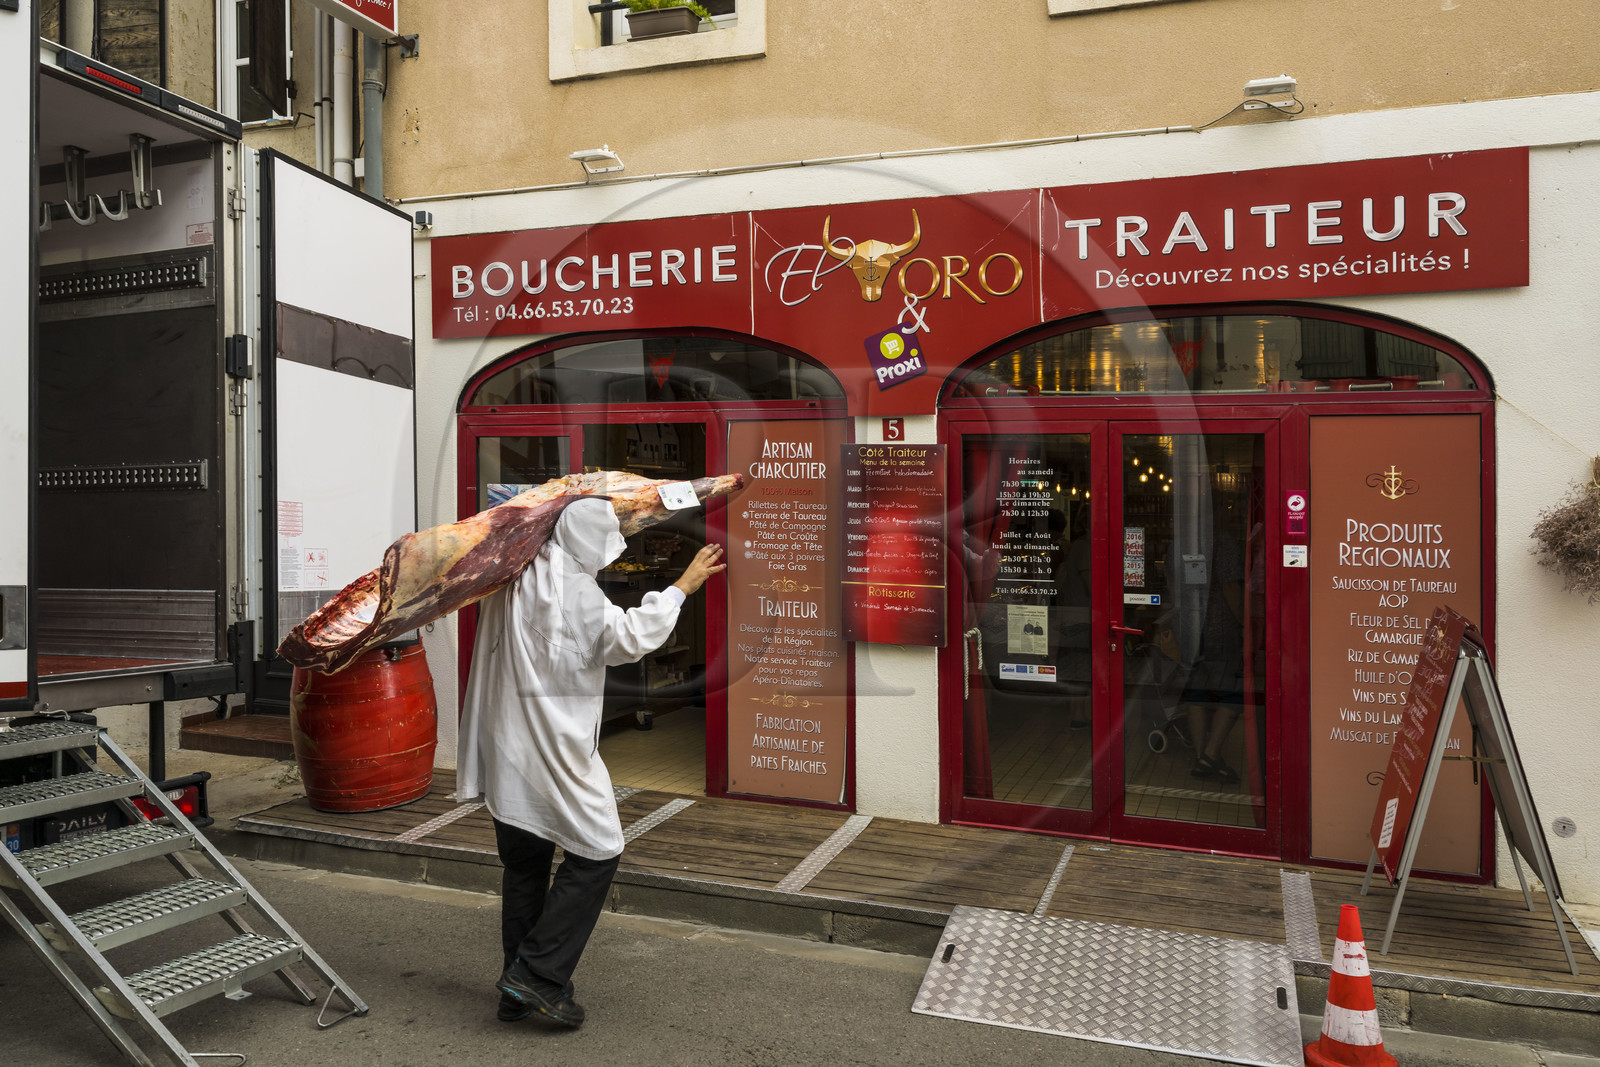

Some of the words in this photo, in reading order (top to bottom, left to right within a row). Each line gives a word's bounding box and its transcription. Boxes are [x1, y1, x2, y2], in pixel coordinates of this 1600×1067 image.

[1064, 192, 1470, 260] TRAITEUR
[451, 244, 738, 299] BOUCHERIE
[1095, 267, 1233, 290] Découvrez
[1241, 262, 1290, 282] nos
[1298, 249, 1452, 283] spécialités
[1463, 249, 1470, 269] !
[898, 253, 1024, 304] ORO
[453, 306, 479, 323] Tél
[495, 297, 634, 322] 04.66.53.70.23
[898, 293, 931, 334] &
[888, 419, 899, 439] 5
[761, 439, 813, 459] ARTISAN
[858, 446, 884, 457] Côté
[887, 446, 927, 458] Traiteur
[749, 462, 826, 479] CHARCUTIER
[1029, 491, 1050, 499] 19h30
[748, 500, 779, 509] Rillettes
[780, 501, 791, 509] de
[793, 501, 828, 510] Taureau
[749, 510, 778, 519] Terrine
[780, 511, 790, 520] de
[792, 511, 827, 520] Taureau
[749, 520, 767, 529] Pâté
[769, 521, 780, 529] de
[781, 521, 827, 532] Campagne
[1346, 518, 1443, 544] PRODUITS
[757, 530, 775, 540] Pâté
[777, 532, 788, 540] en
[789, 531, 819, 540] Croûte
[999, 531, 1021, 539] Juillet
[753, 540, 789, 551] Fromage
[791, 541, 802, 550] de
[805, 541, 823, 551] Tête
[1023, 543, 1060, 551] dimanche
[751, 550, 769, 560] Pâté
[770, 552, 786, 560] aux
[789, 552, 794, 560] 3
[796, 552, 825, 562] poivres
[1339, 542, 1451, 569] REGIONAUX
[768, 561, 785, 570] Foie
[787, 562, 807, 571] Gras
[869, 586, 916, 599] Rôtisserie
[1332, 576, 1390, 592] SAUCISSON
[1393, 580, 1407, 592] DE
[1409, 578, 1457, 594] TAUREAU
[758, 596, 818, 619] TRAITEUR
[1379, 594, 1409, 608] AOP
[1350, 612, 1383, 627] FLEUR
[1386, 616, 1400, 628] DE
[1402, 615, 1422, 629] SEL
[739, 623, 782, 633] Découvrez
[784, 625, 795, 635] les
[797, 627, 838, 638] spécialités
[1365, 629, 1424, 646] CAMARGUE
[762, 635, 772, 644] de
[774, 636, 782, 644] la
[784, 636, 814, 647] Région.
[737, 643, 754, 653] Nos
[756, 645, 775, 654] plats
[777, 646, 807, 656] cuisinés
[809, 649, 840, 658] maison.
[1348, 648, 1363, 663] RIZ
[1366, 651, 1380, 664] DE
[744, 654, 769, 663] Notre
[770, 657, 798, 665] service
[799, 657, 833, 668] Traiteur
[758, 667, 777, 675] pour
[795, 669, 818, 678] repas
[1354, 668, 1385, 684] HUILE
[752, 674, 824, 688] Apéro-Dînatoires.
[1352, 688, 1375, 704] VINS
[1378, 691, 1397, 705] DES
[756, 712, 822, 734] FABRICATION
[1339, 707, 1362, 723] VINS
[1365, 711, 1380, 724] DU
[752, 732, 809, 753] ARTISANALE
[811, 740, 825, 755] DE
[1330, 727, 1373, 743] MUSCAT
[1376, 732, 1390, 745] DE
[750, 755, 778, 770] PATES
[781, 755, 827, 775] FRAICHES
[7, 840, 19, 851] 30
